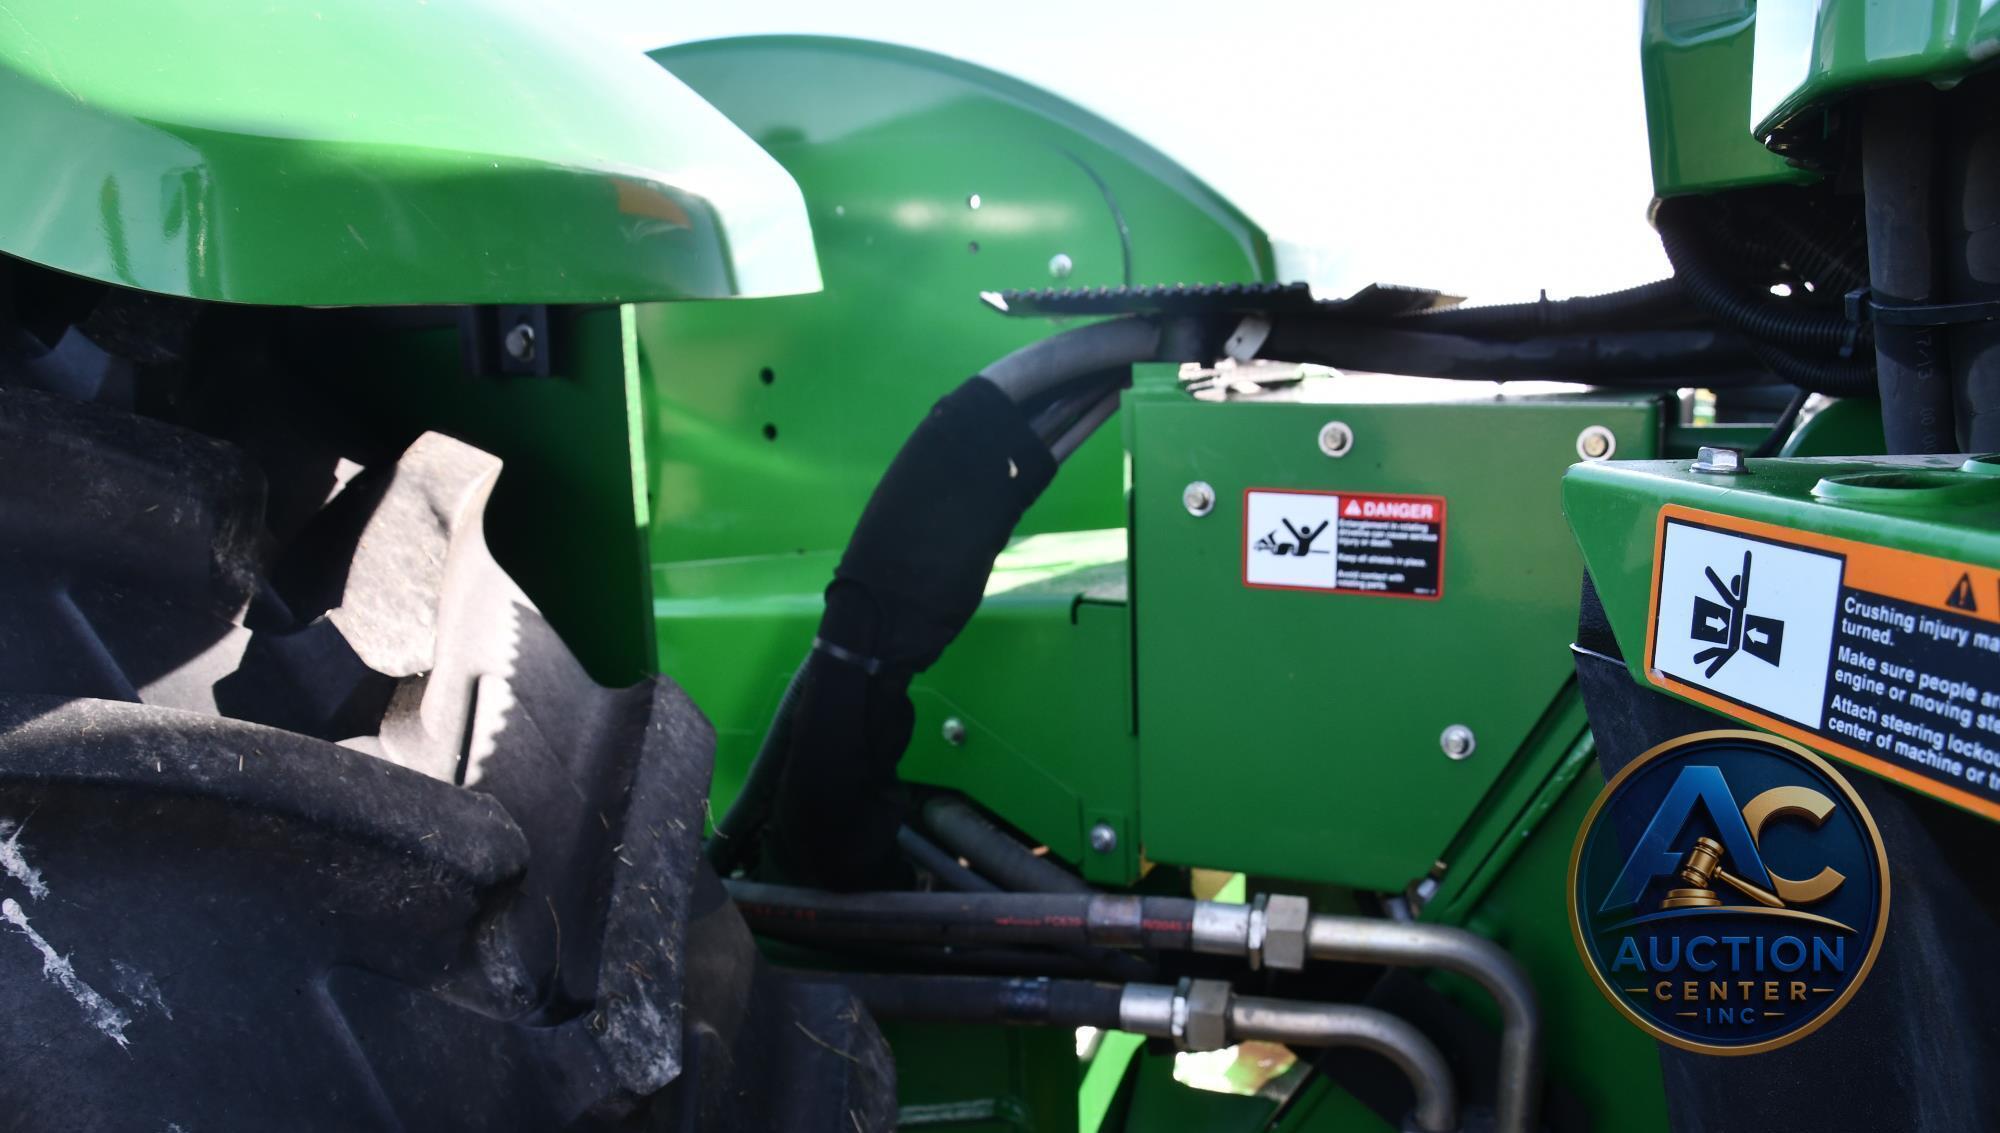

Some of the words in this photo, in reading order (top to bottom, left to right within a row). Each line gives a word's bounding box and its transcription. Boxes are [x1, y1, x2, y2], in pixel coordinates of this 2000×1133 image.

[1363, 501, 1433, 519] DANGER
[1842, 618, 1895, 647] turned.
[1844, 596, 1916, 634] Crushing
[1919, 615, 1969, 648] injury
[1834, 668, 1885, 695] engine
[1888, 686, 1907, 702] or
[1909, 692, 1973, 728] moving
[1838, 645, 1877, 671] Make
[1880, 661, 1915, 683] sure
[1918, 673, 1977, 701] people
[1828, 717, 1874, 743] center
[1876, 734, 1894, 750] of
[1895, 740, 1963, 777] machine
[1965, 766, 1986, 784] or
[1830, 694, 1877, 724] Attach
[1880, 713, 1945, 751] steering
